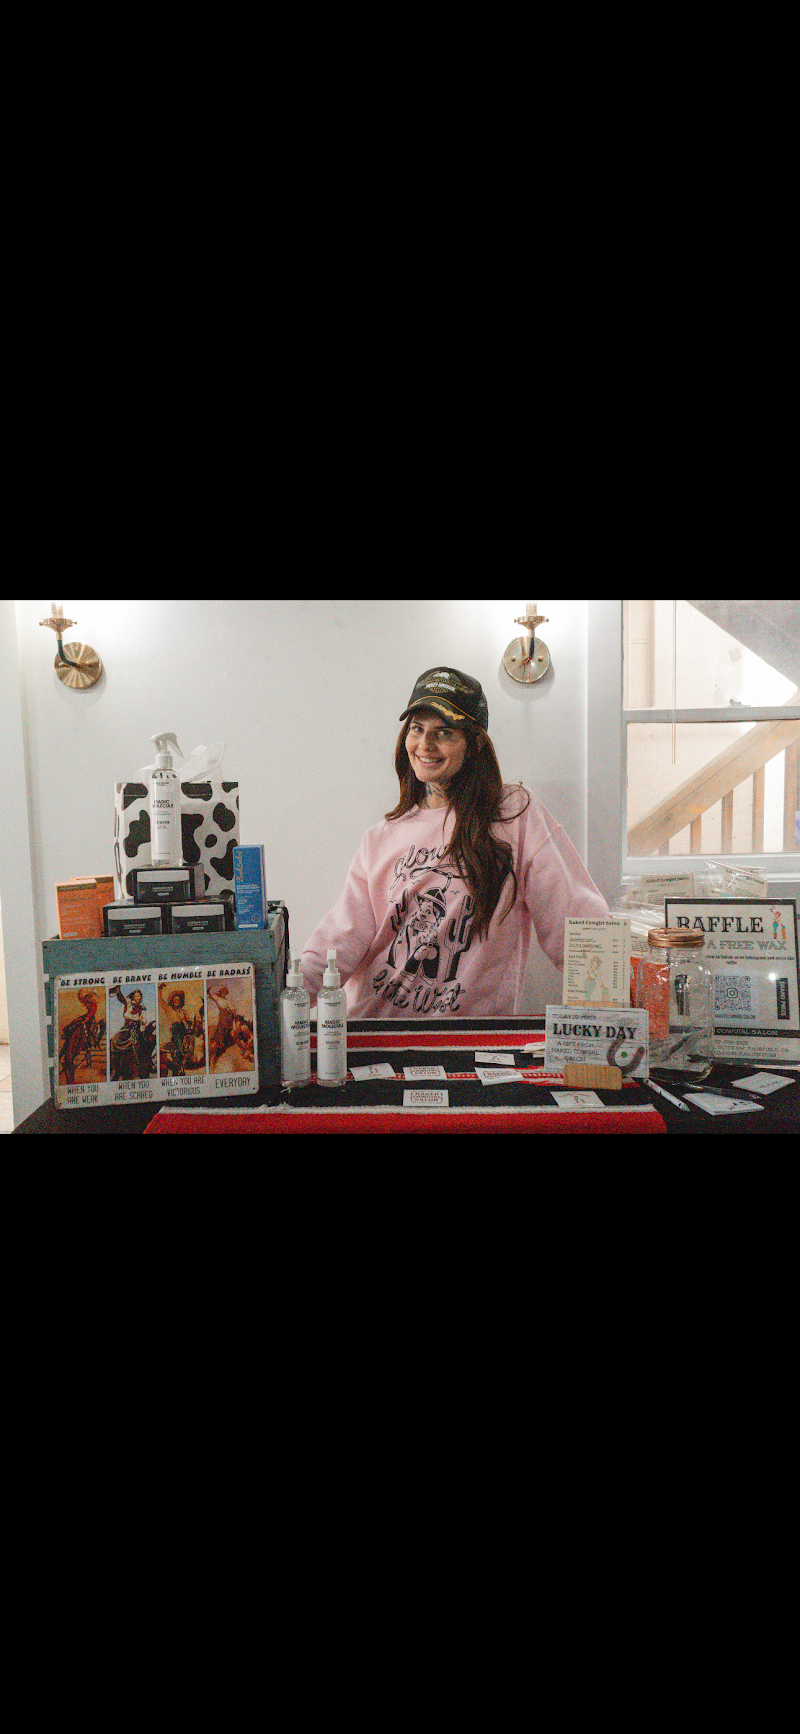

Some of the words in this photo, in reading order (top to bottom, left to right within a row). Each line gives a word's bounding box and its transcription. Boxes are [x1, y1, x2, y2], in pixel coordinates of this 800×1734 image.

[675, 916, 764, 933] RAFFLE
[706, 939, 717, 949] A
[719, 940, 754, 950] FREE
[756, 940, 788, 951] WAX
[158, 973, 168, 981] BE
[170, 971, 203, 980] HUMBLE
[219, 968, 251, 976] BADASS
[60, 979, 71, 987] BE
[73, 977, 106, 986] STRONG
[112, 976, 122, 984] BE
[125, 974, 152, 982] BRAVE
[552, 1022, 603, 1038] LUCKY
[605, 1025, 638, 1040] DAY
[716, 1027, 750, 1035] COWGIRL
[573, 1048, 600, 1056] COWGIRL
[118, 1080, 136, 1090] WHEN
[138, 1080, 150, 1089] YOU
[161, 1077, 178, 1087] WHEN
[180, 1076, 192, 1086] YOU
[193, 1075, 205, 1085] ARE
[215, 1076, 251, 1089] EVERYDAY
[67, 1085, 85, 1094] WHEN
[87, 1084, 99, 1093] YOU
[166, 1086, 201, 1097] VICTORIOUS
[67, 1096, 80, 1105] ARE
[82, 1094, 99, 1104] WEAK
[114, 1092, 126, 1101] ARE
[129, 1090, 153, 1100] SCARED
